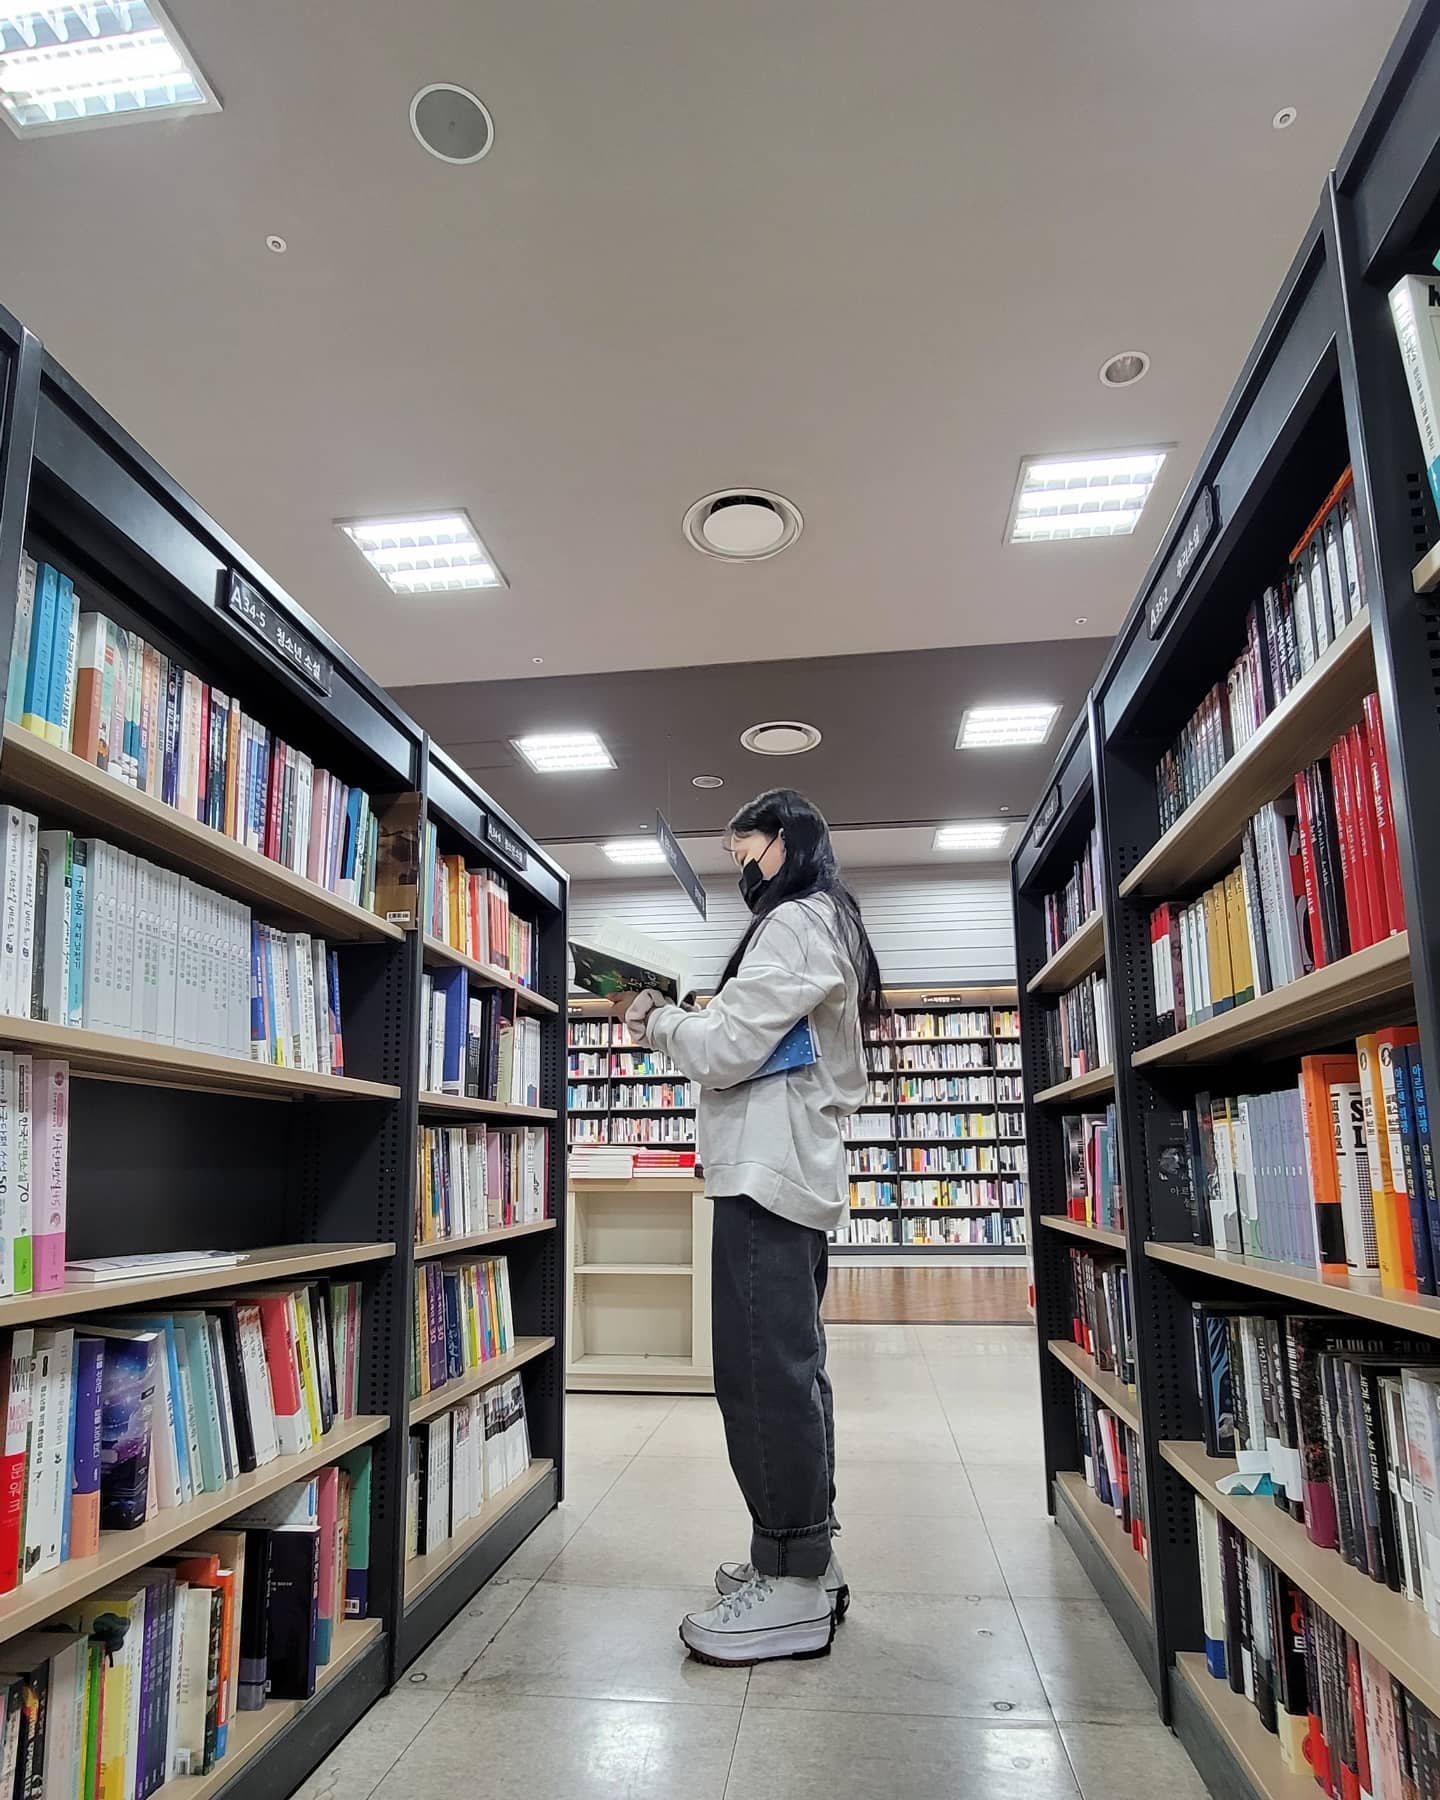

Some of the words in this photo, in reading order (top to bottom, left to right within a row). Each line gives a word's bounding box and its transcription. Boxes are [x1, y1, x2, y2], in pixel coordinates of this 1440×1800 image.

[1150, 586, 1169, 631] A35-2
[1176, 523, 1200, 579] 추리소설
[230, 586, 266, 628] A34-5
[276, 627, 302, 663] 청소년
[304, 655, 321, 681] 소설
